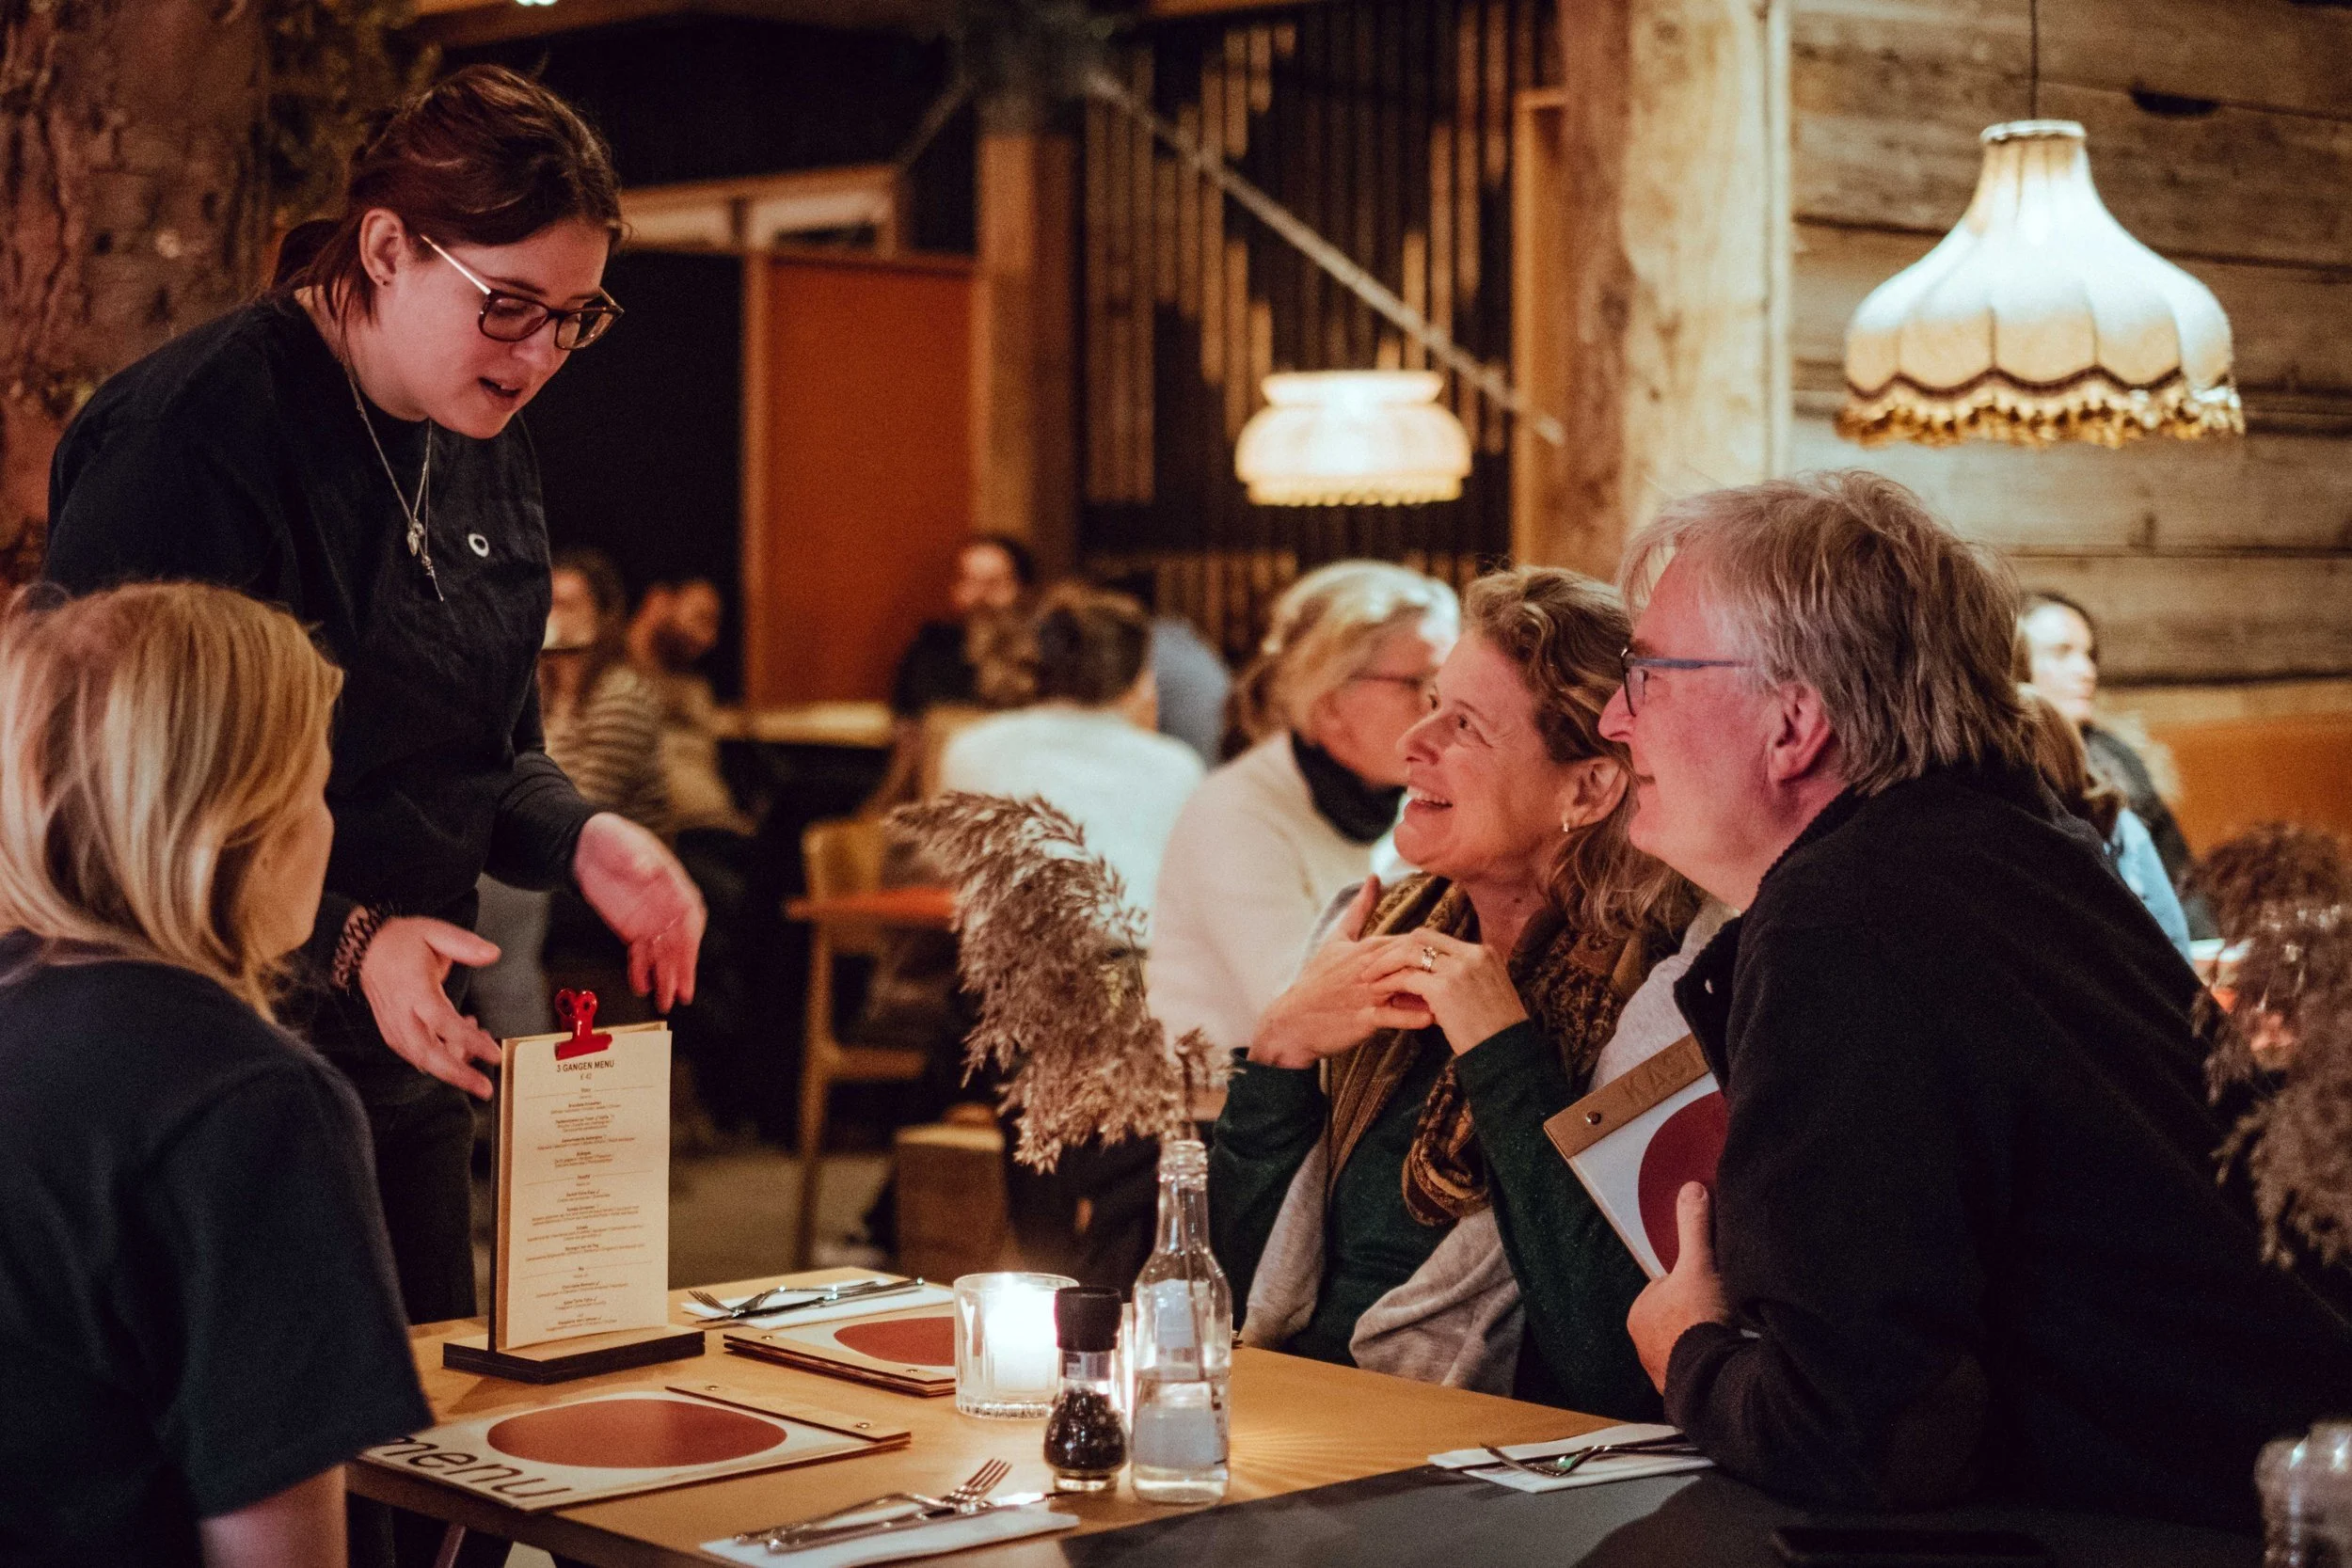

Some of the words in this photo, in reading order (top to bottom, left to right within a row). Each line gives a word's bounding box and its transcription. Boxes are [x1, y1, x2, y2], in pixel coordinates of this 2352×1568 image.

[557, 1064, 563, 1072] 3
[563, 1061, 593, 1072] GANGEN
[594, 1060, 615, 1069] MENU
